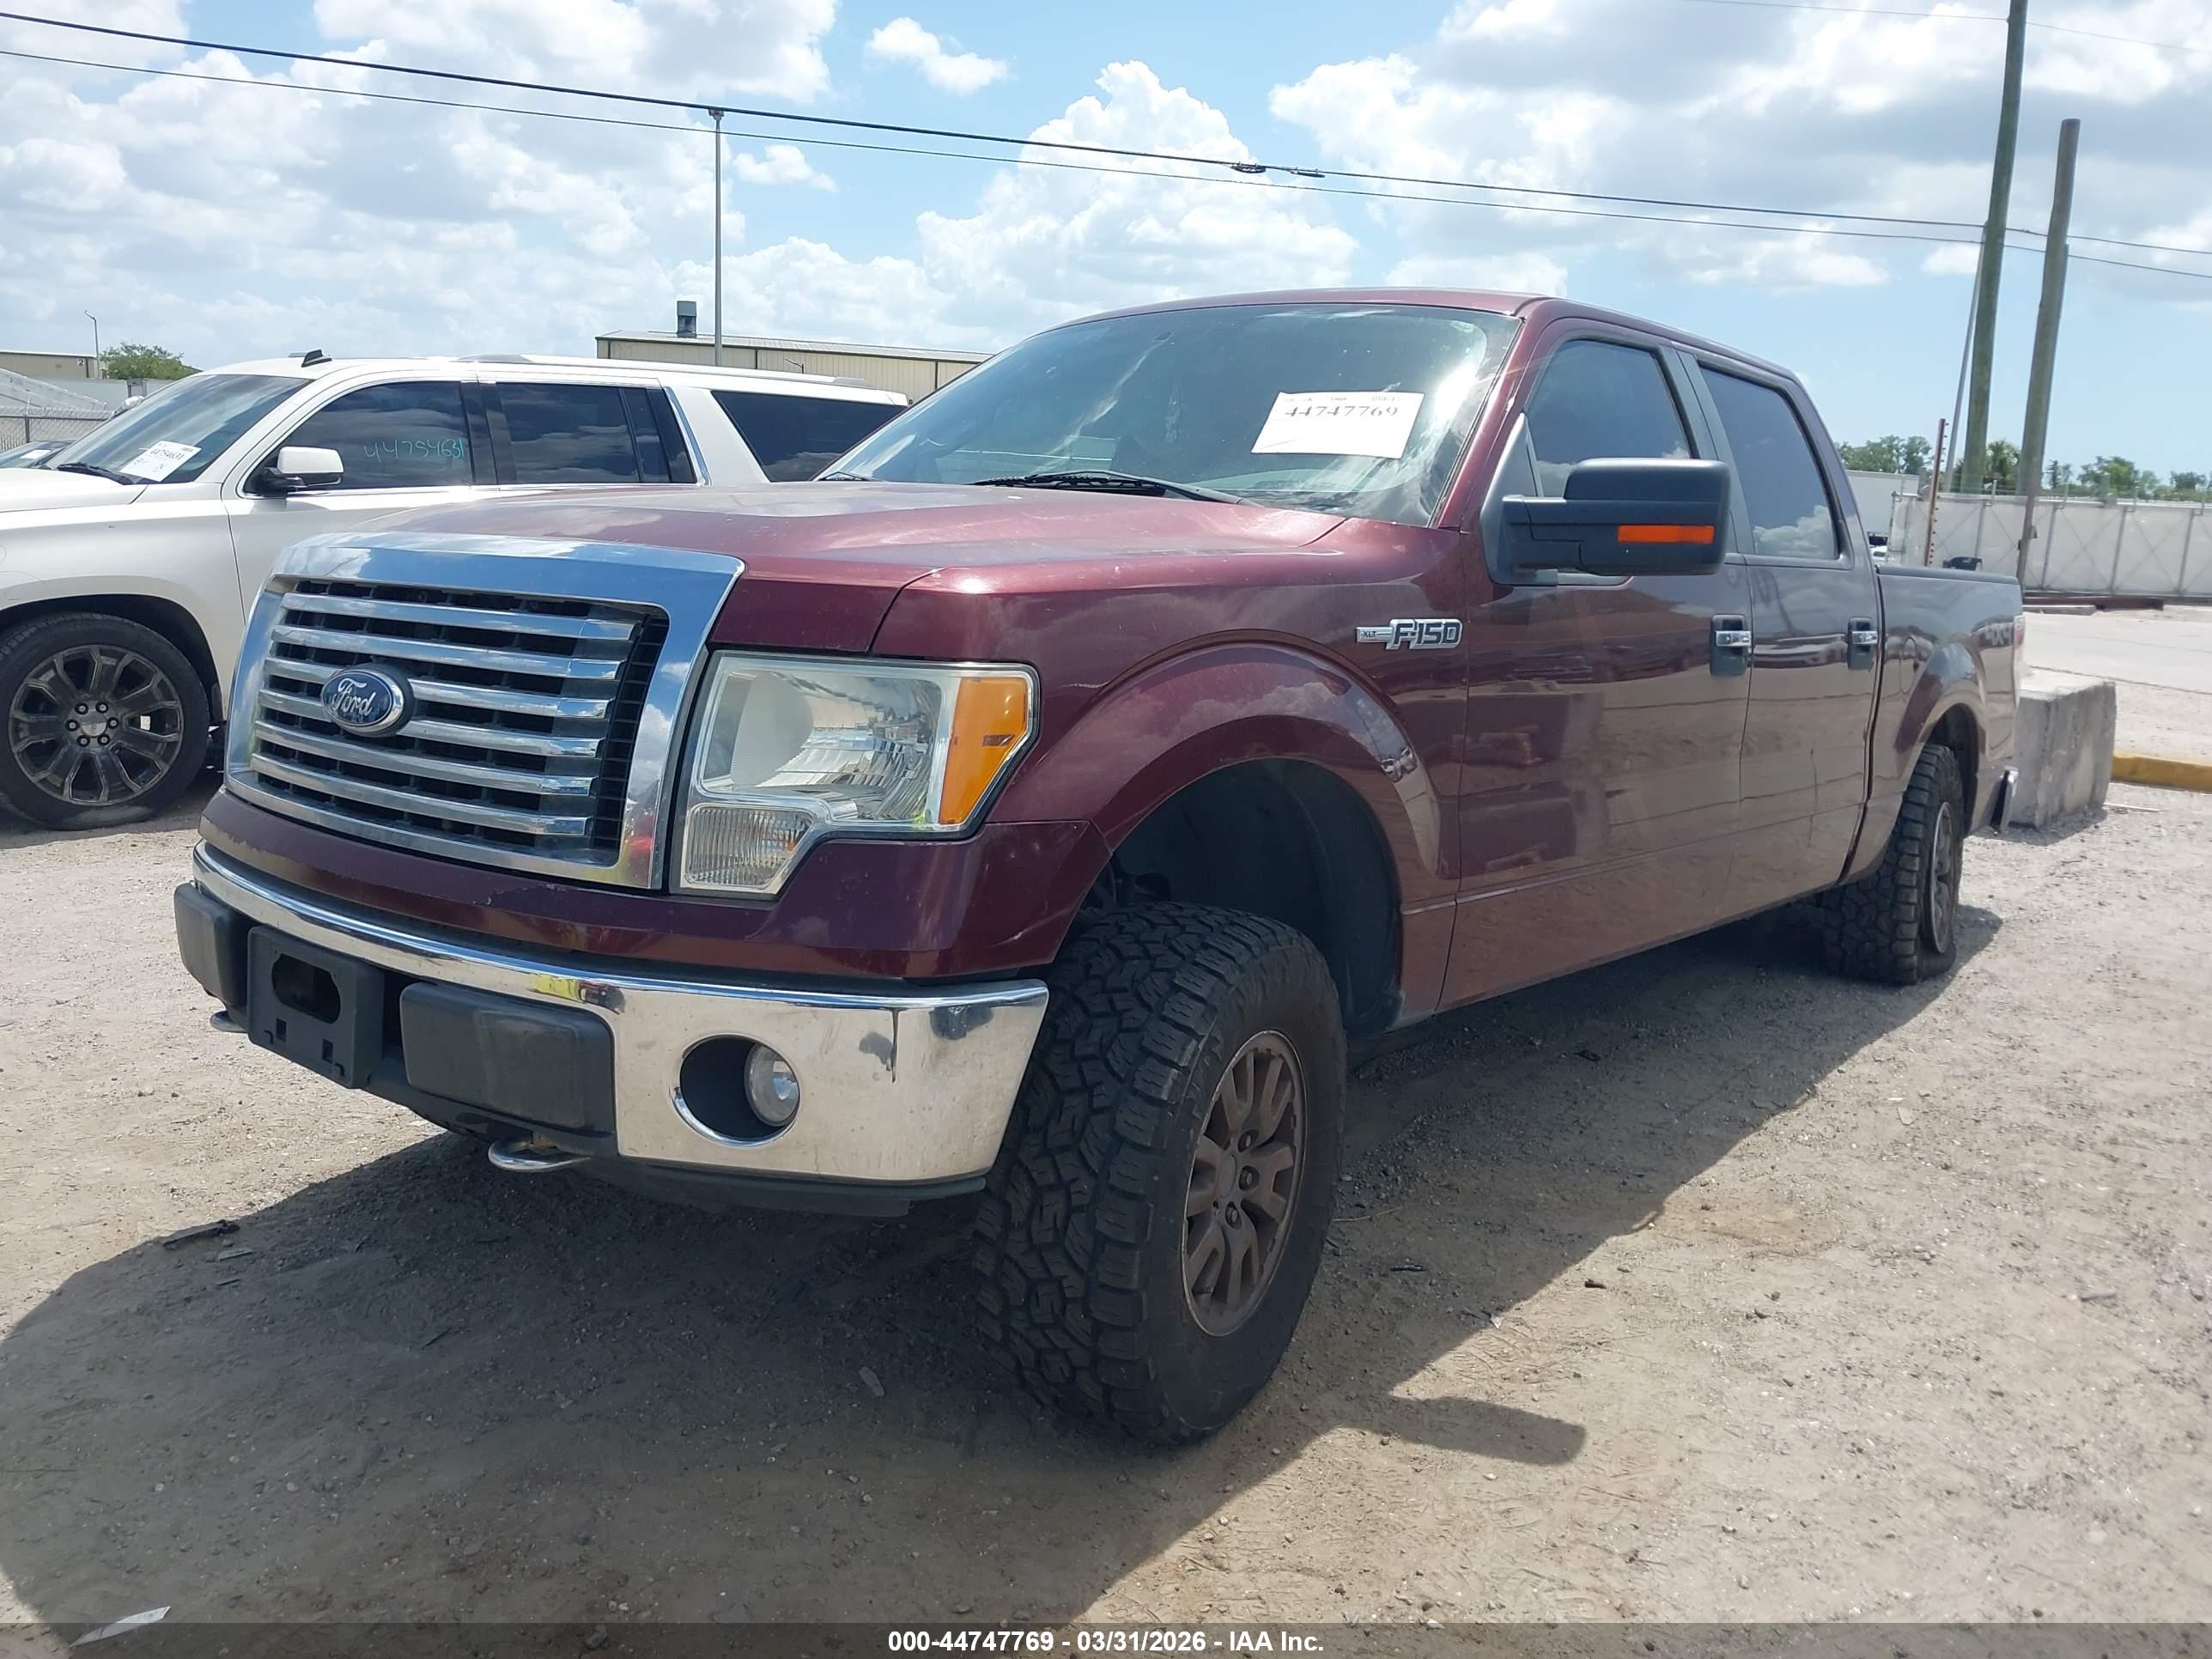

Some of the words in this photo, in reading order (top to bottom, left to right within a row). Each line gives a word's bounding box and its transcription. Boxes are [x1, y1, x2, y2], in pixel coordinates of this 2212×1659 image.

[1285, 405, 1398, 416] 44747769
[364, 439, 465, 462] 44754631
[331, 678, 377, 716] Ford
